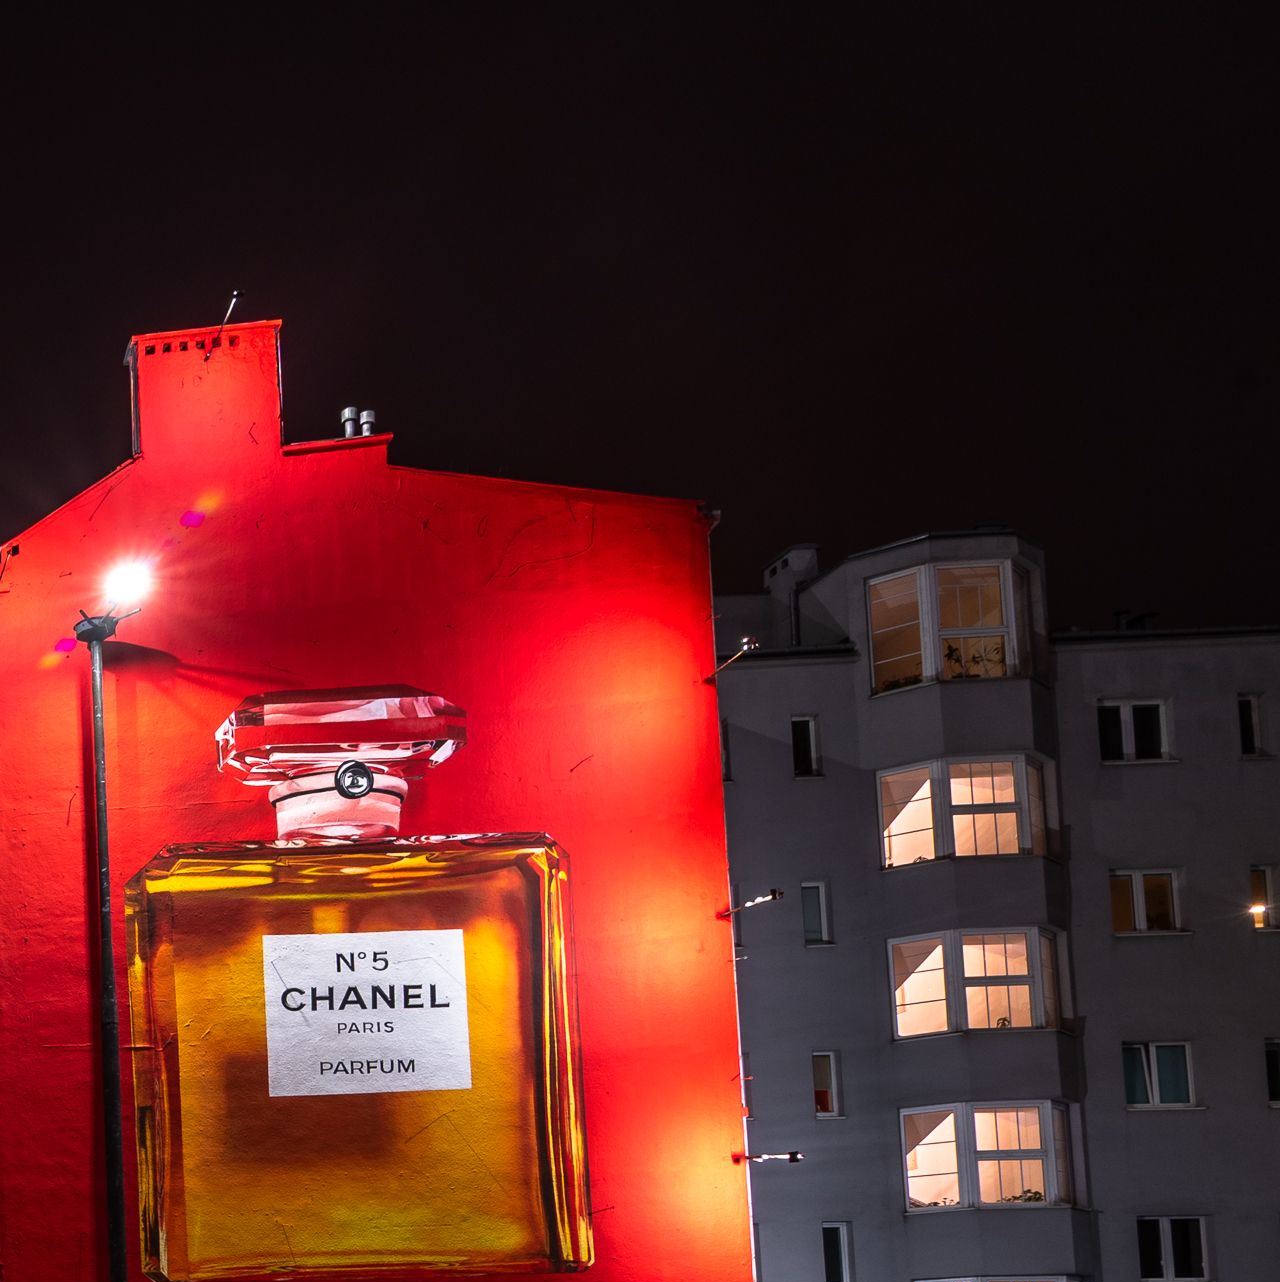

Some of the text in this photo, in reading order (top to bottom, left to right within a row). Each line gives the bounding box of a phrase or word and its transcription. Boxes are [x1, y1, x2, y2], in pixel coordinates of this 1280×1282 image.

[280, 983, 450, 1012] CHANEL
[337, 1021, 395, 1034] PARIS
[319, 1058, 415, 1075] PARFUM
